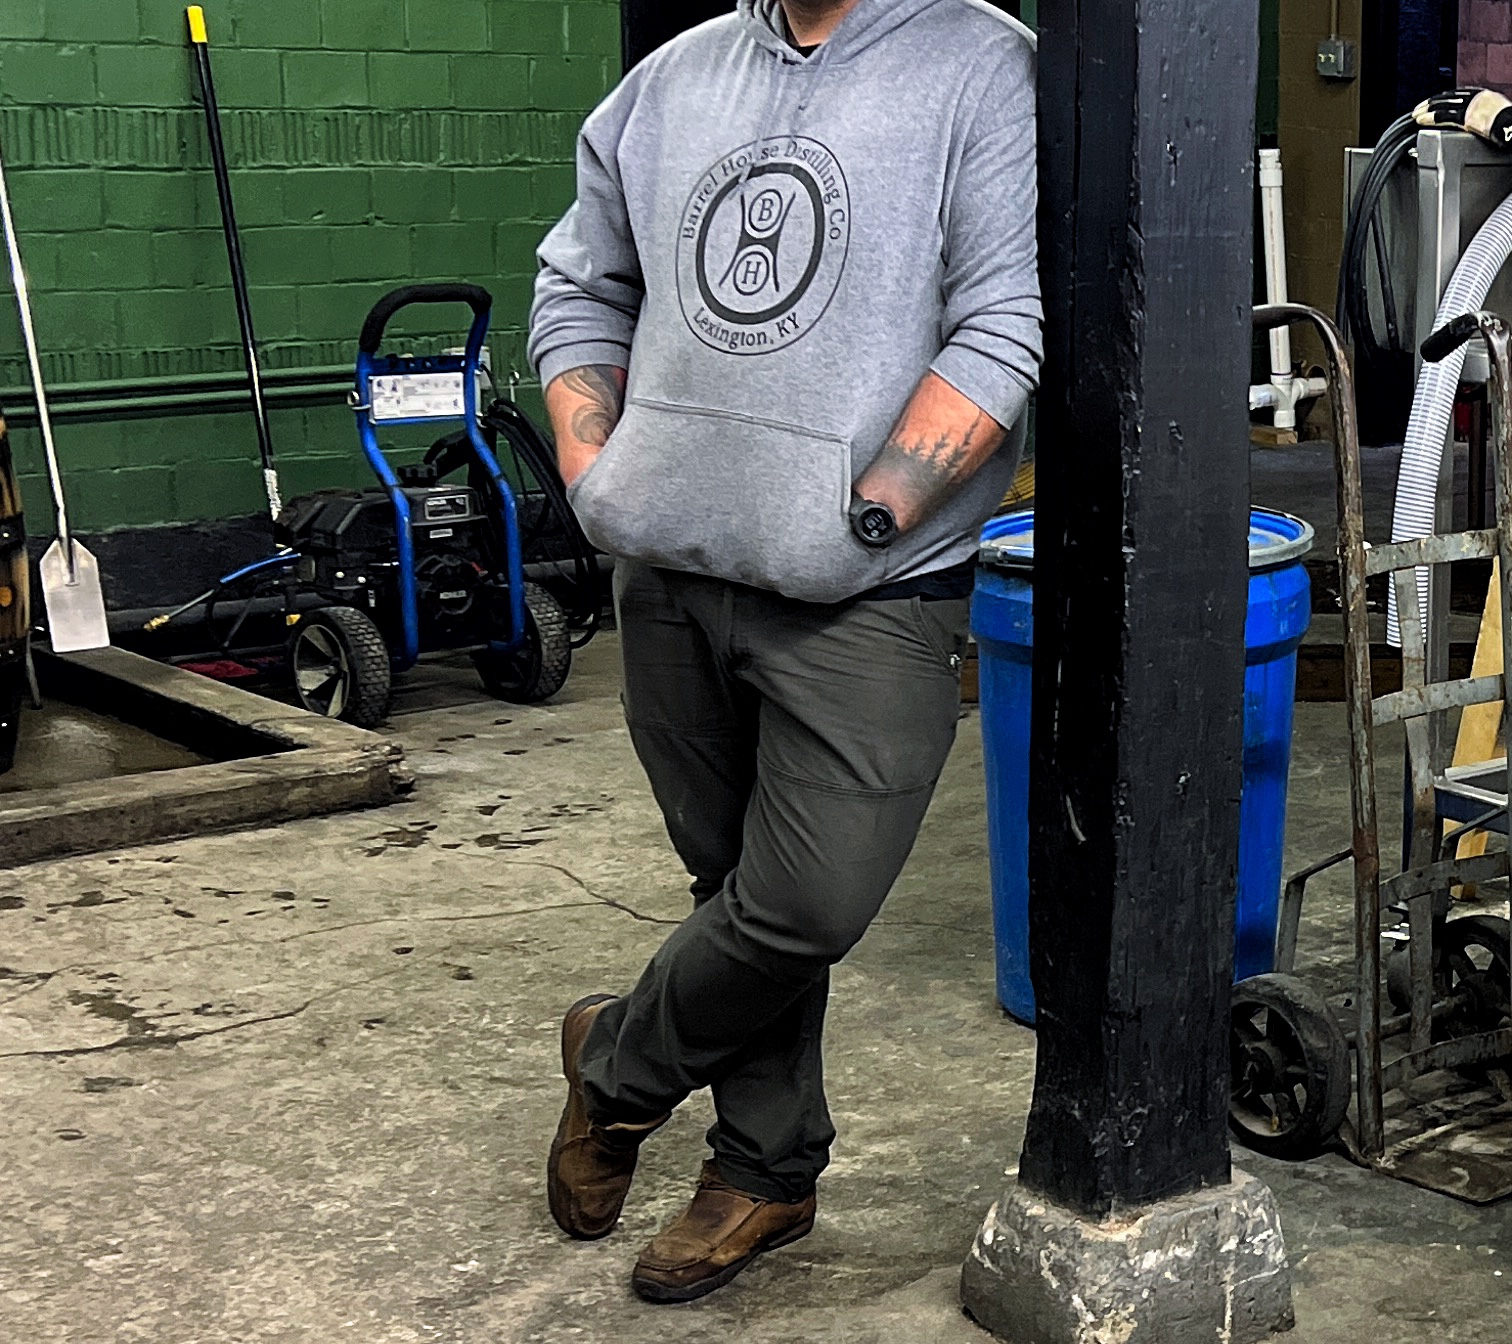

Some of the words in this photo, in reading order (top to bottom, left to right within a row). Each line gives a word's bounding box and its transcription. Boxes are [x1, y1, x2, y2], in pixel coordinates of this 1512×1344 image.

[682, 173, 719, 240] Barrel
[783, 140, 841, 205] Distilling
[757, 198, 775, 222] B
[741, 260, 762, 285] H
[775, 312, 800, 338] KY
